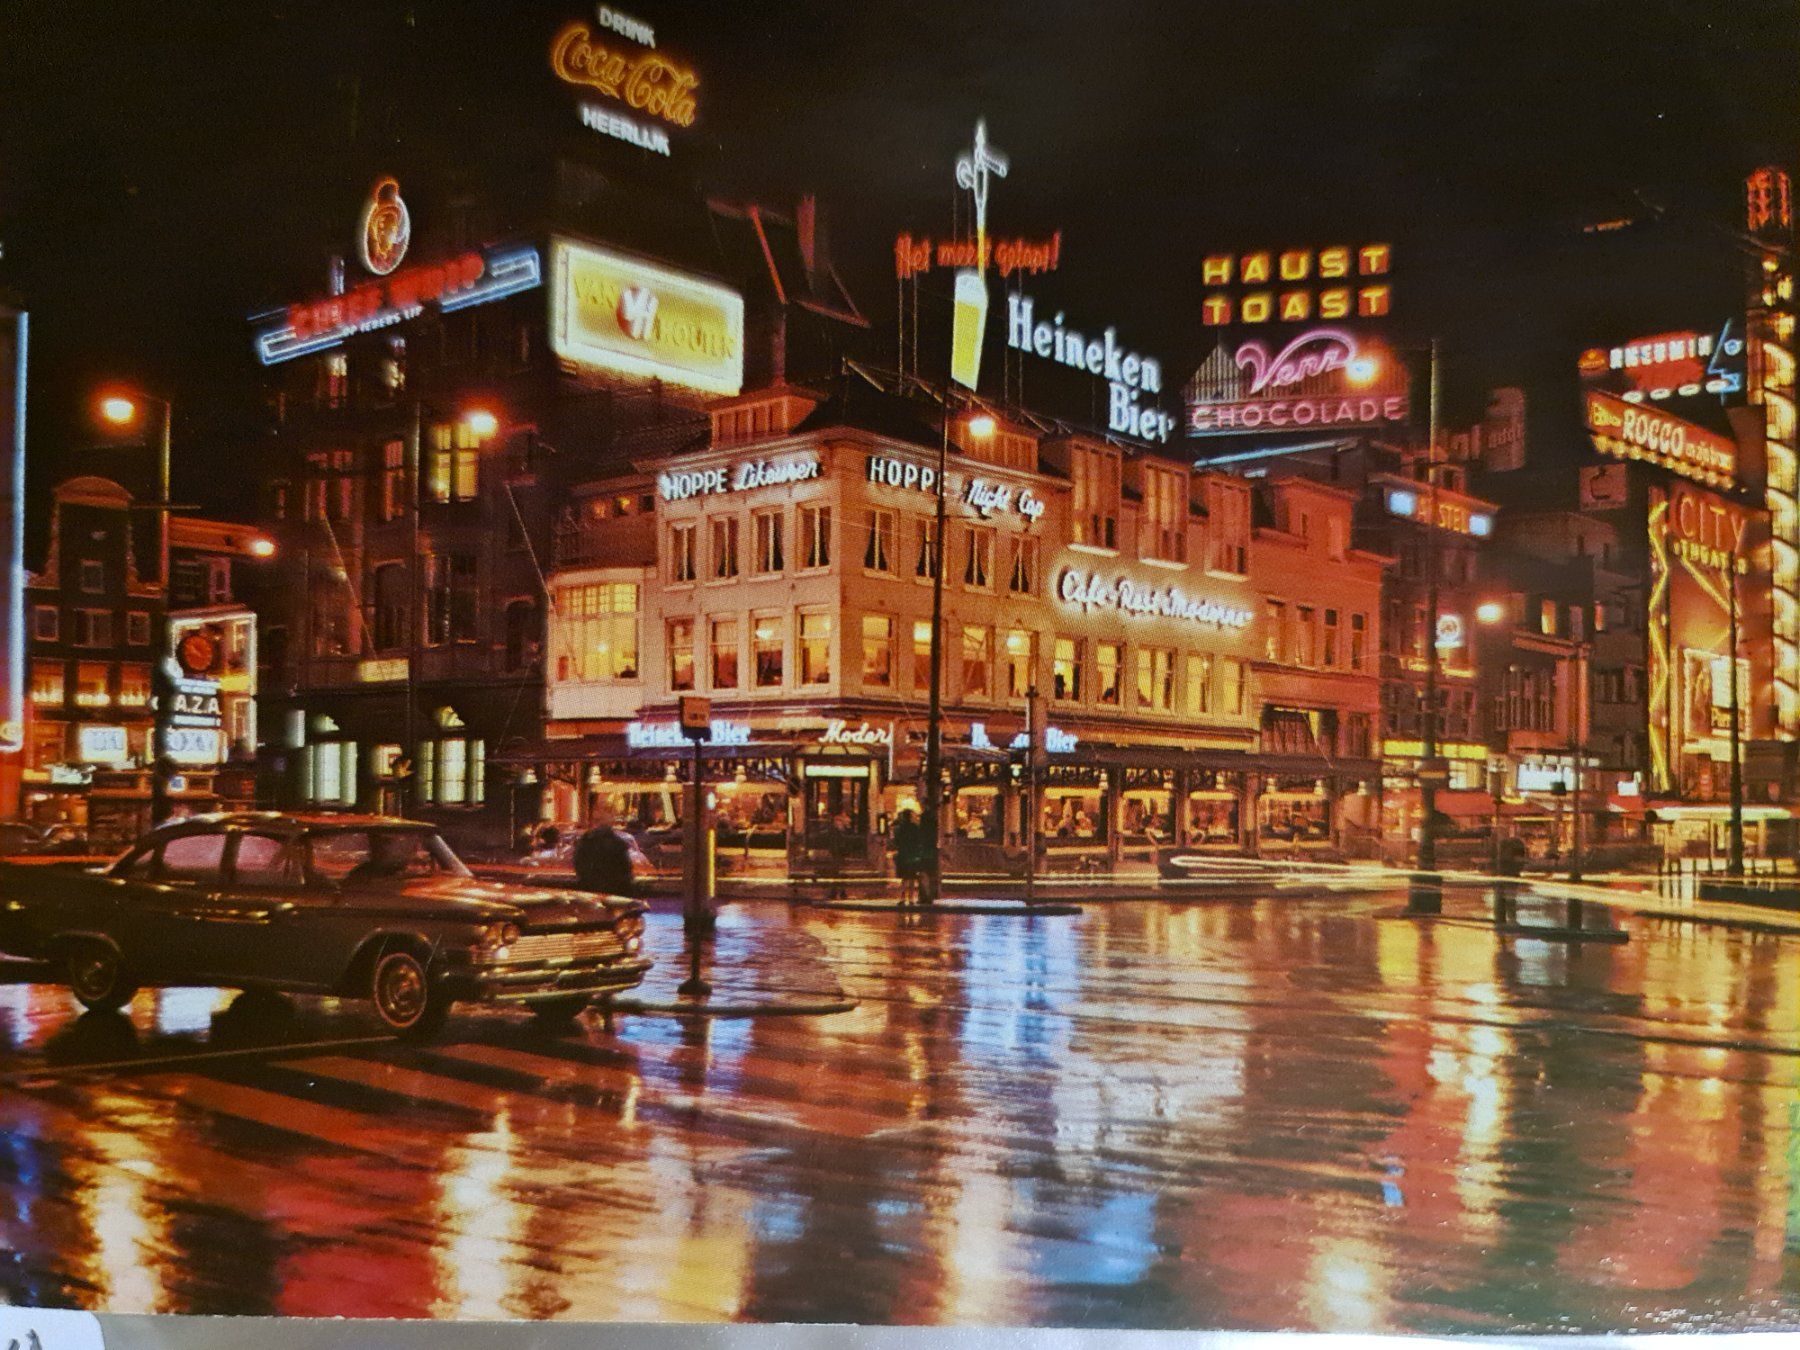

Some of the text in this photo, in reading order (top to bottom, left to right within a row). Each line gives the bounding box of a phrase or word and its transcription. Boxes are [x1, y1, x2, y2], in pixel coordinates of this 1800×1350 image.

[599, 6, 656, 49] DRINK
[580, 104, 671, 157] HEERLIJK
[1203, 244, 1391, 286] HAUST
[1202, 286, 1392, 327] TOAST
[1007, 292, 1162, 394] Heineken
[1107, 380, 1176, 444] Bier
[1190, 396, 1405, 430] CHOCOLADE
[1622, 407, 1686, 459] ROCCO
[657, 467, 729, 502] HOPPE
[1680, 496, 1747, 555] CITY
[1679, 538, 1748, 576] THEATR
